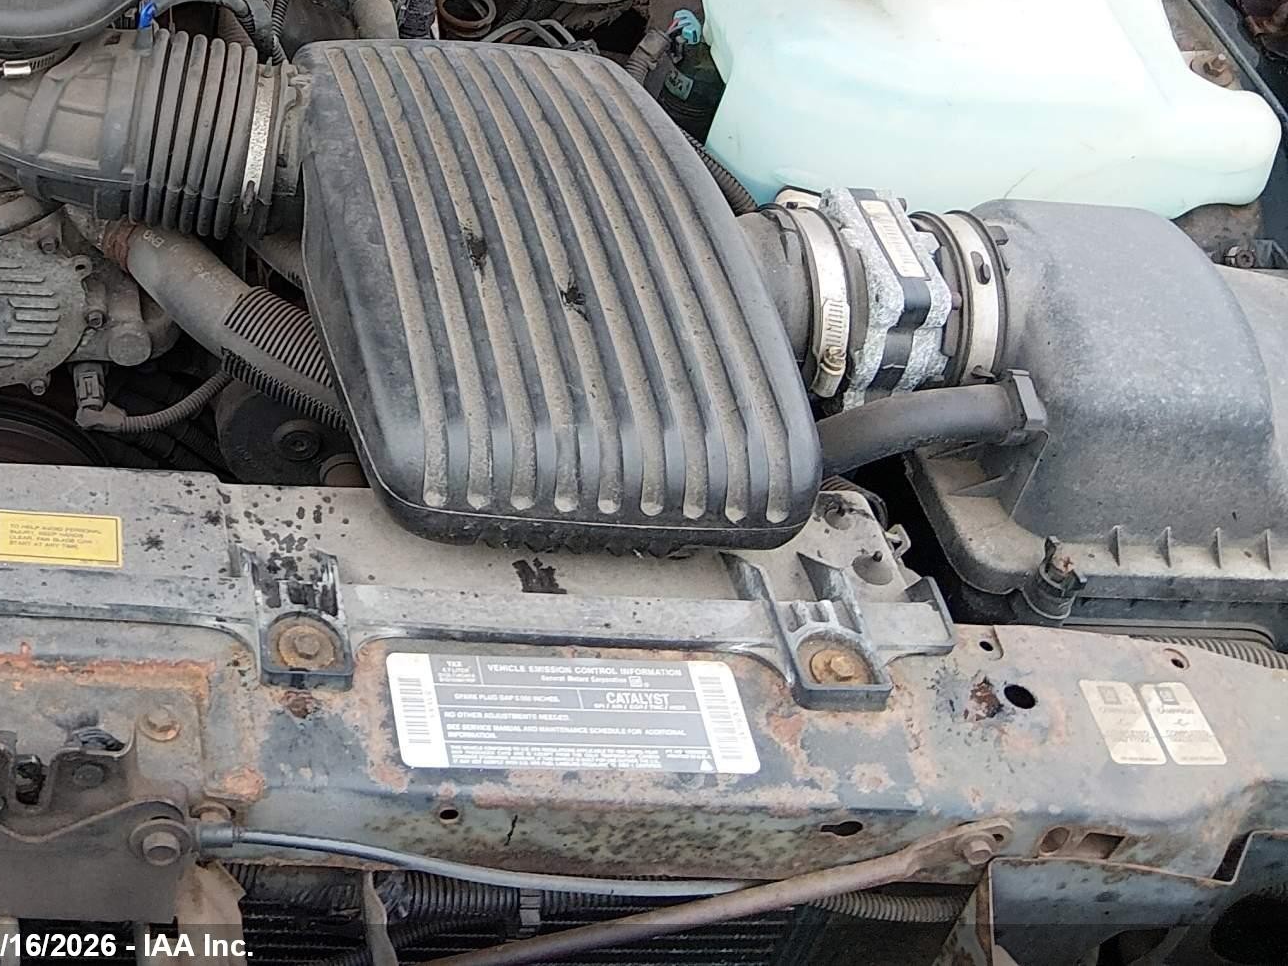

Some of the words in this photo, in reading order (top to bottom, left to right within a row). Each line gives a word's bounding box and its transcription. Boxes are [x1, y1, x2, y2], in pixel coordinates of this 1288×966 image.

[487, 663, 527, 673] VEHICLE
[529, 664, 572, 674] EMISSION
[574, 666, 618, 675] CONTROL
[619, 667, 683, 676] INFORMATION
[605, 691, 670, 705] CATALYST
